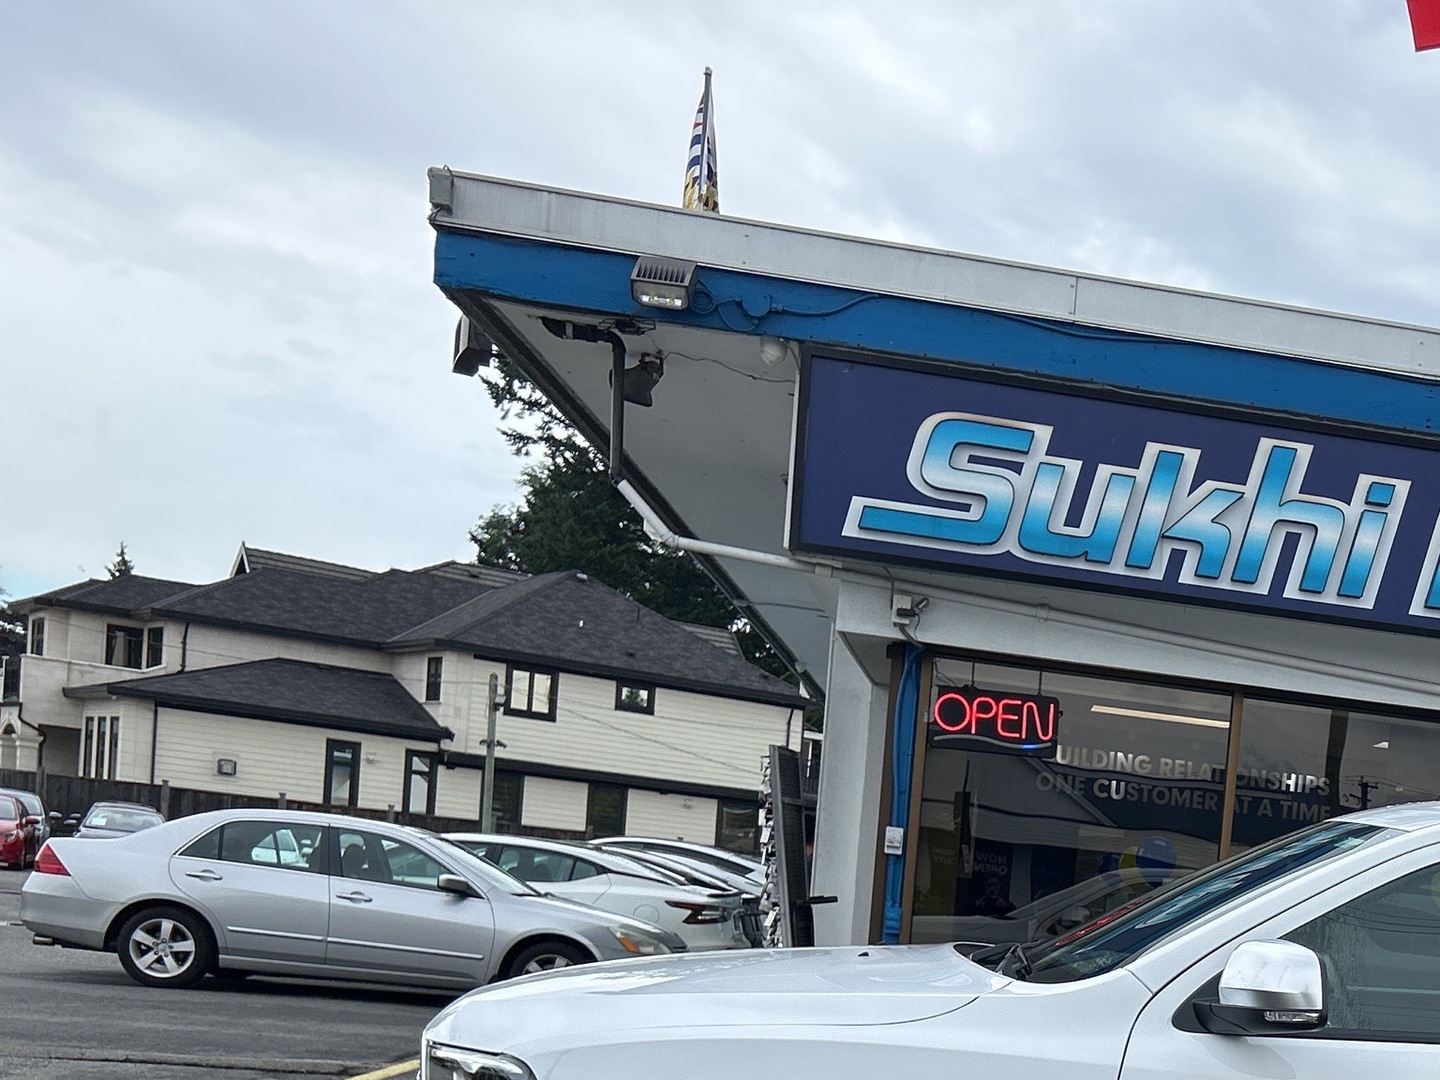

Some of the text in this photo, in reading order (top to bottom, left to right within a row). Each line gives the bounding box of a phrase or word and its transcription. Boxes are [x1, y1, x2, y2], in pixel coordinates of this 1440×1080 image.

[842, 410, 1410, 609] Sukhi
[933, 692, 1055, 742] OPEN
[1035, 771, 1086, 795] ONE
[1093, 778, 1218, 811] CUSTOMER
[1256, 798, 1273, 817] A
[1041, 744, 1331, 796] UILDING RELATONSHIPS
